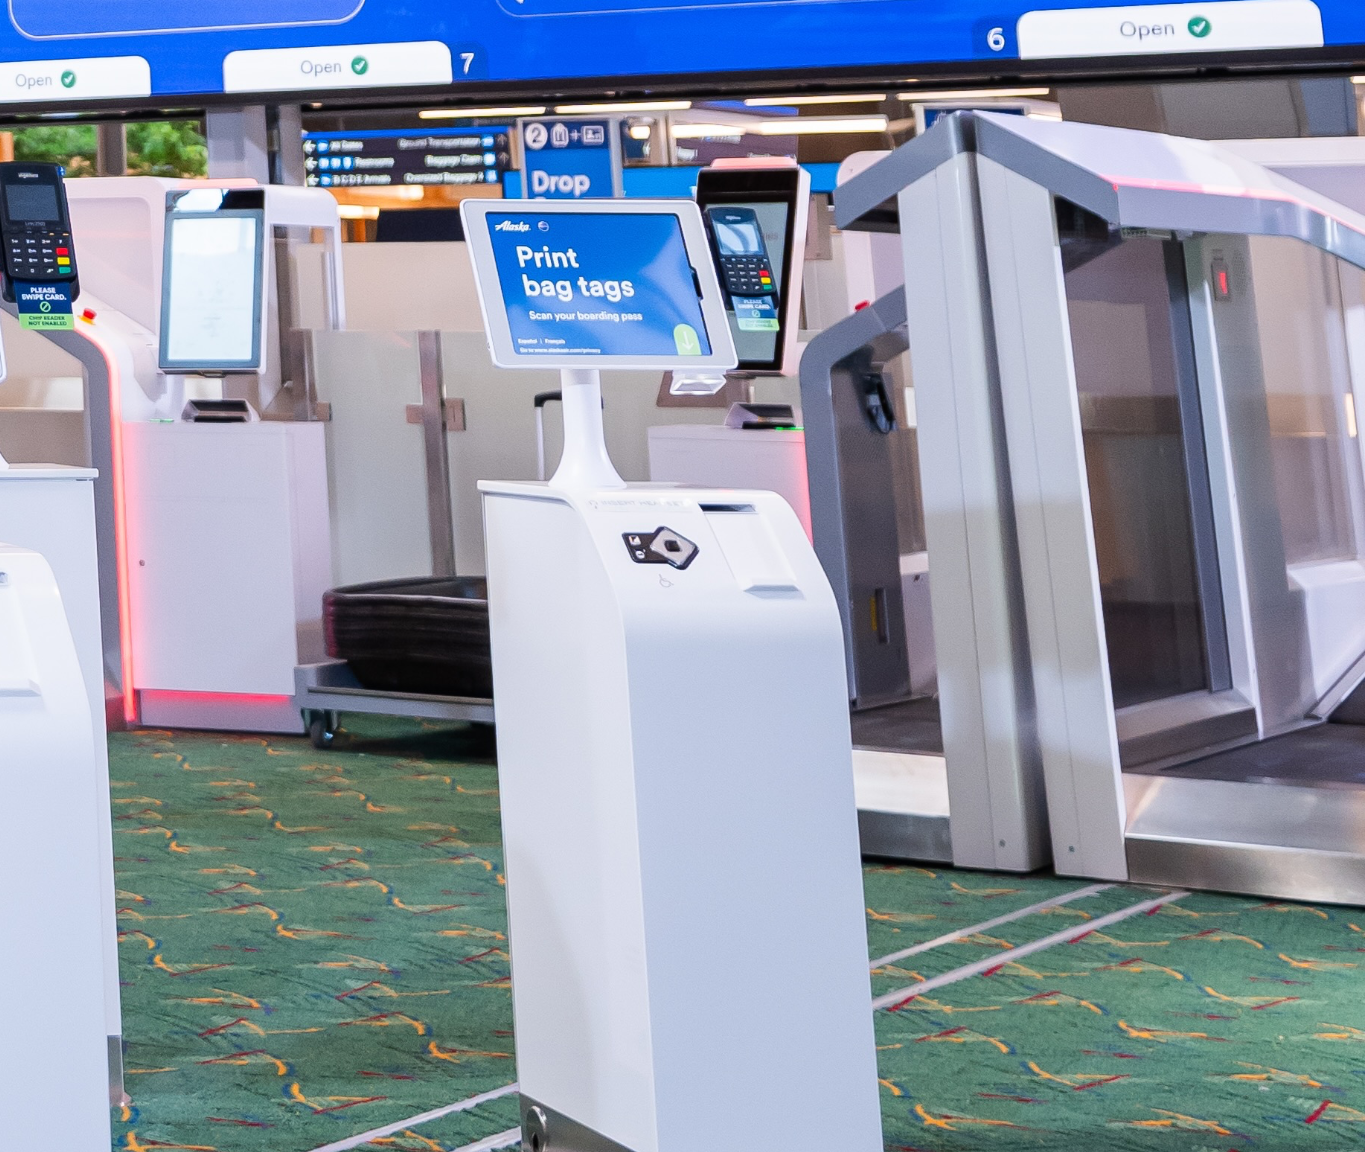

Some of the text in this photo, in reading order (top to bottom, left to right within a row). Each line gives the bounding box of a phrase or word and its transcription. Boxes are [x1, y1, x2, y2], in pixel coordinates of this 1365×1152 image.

[987, 27, 1005, 52] 6
[1120, 21, 1175, 40] Open
[300, 59, 342, 76] Open
[459, 52, 475, 74] 7
[15, 72, 52, 89] Open
[530, 128, 542, 144] 2
[532, 171, 590, 196] Drop
[516, 245, 579, 268] Print
[521, 273, 635, 303] bag tags
[529, 311, 643, 322] Scan your boarding pass
